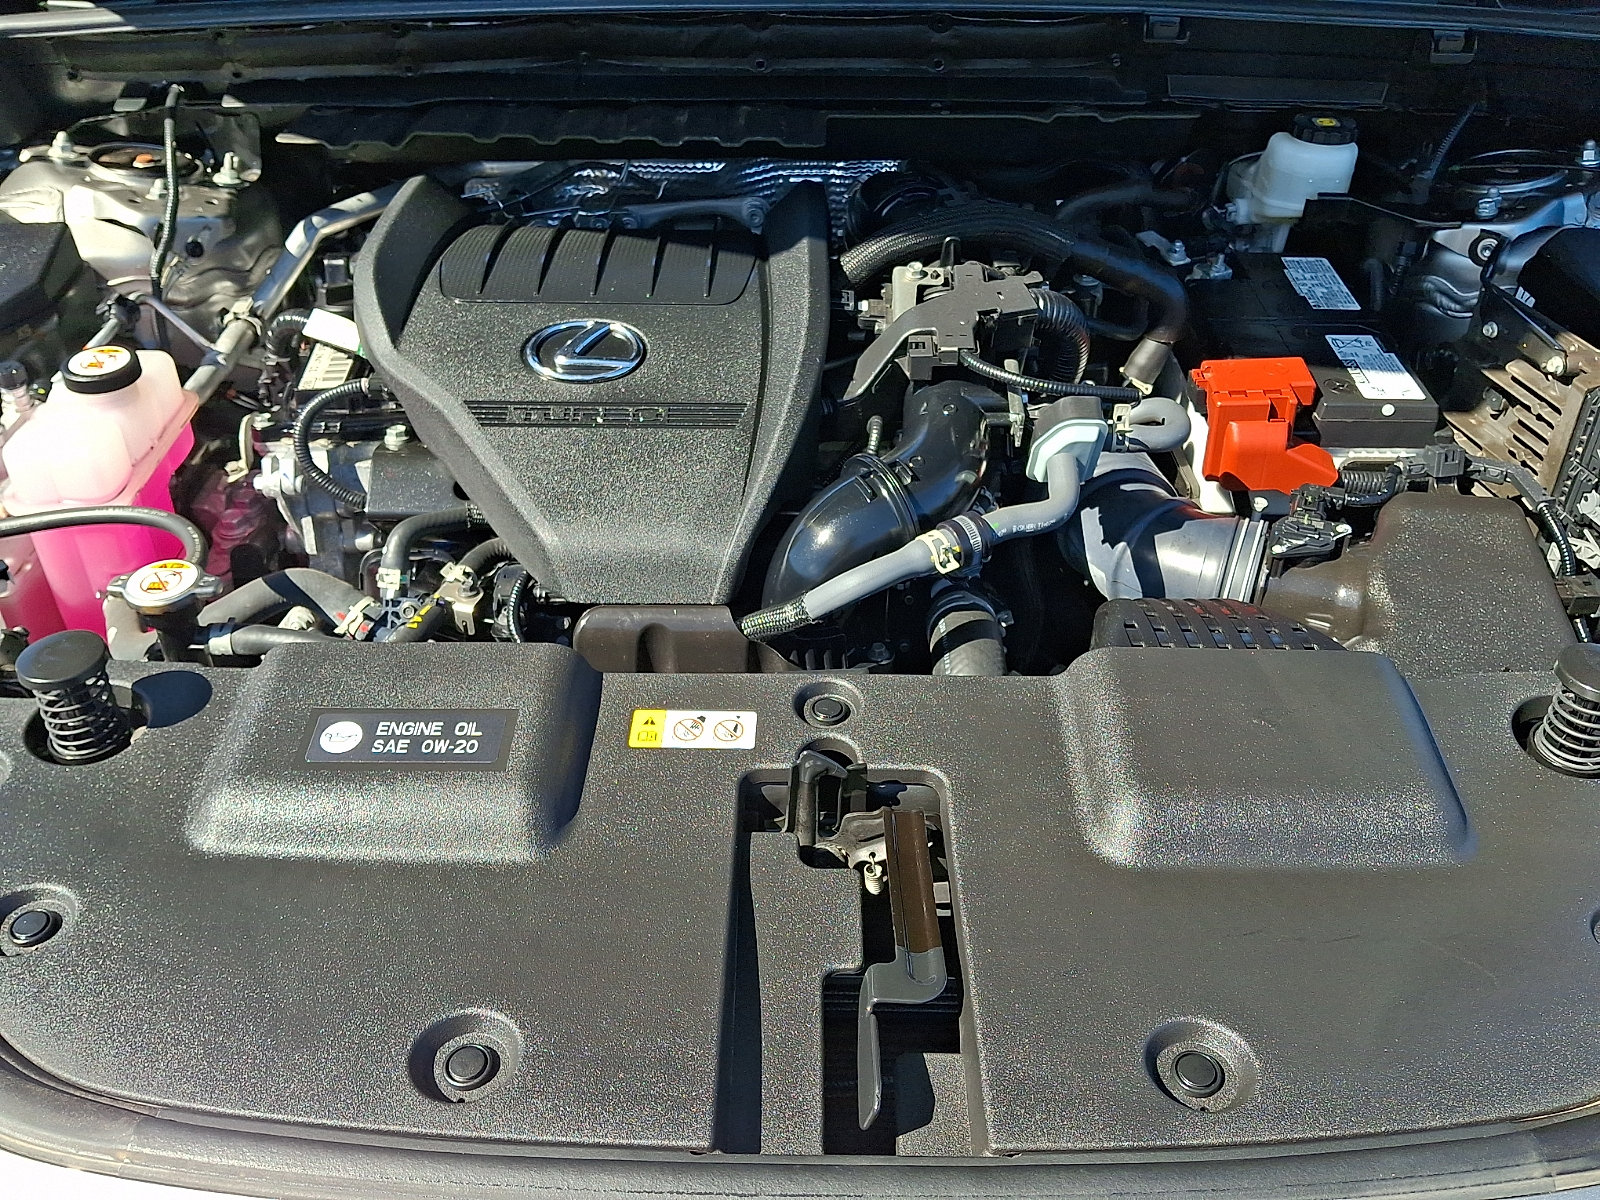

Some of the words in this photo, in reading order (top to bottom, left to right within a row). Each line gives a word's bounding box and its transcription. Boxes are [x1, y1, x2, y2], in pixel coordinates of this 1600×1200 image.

[375, 721, 444, 736] ENGINE
[454, 721, 483, 736] OIL
[371, 739, 411, 754] SAE
